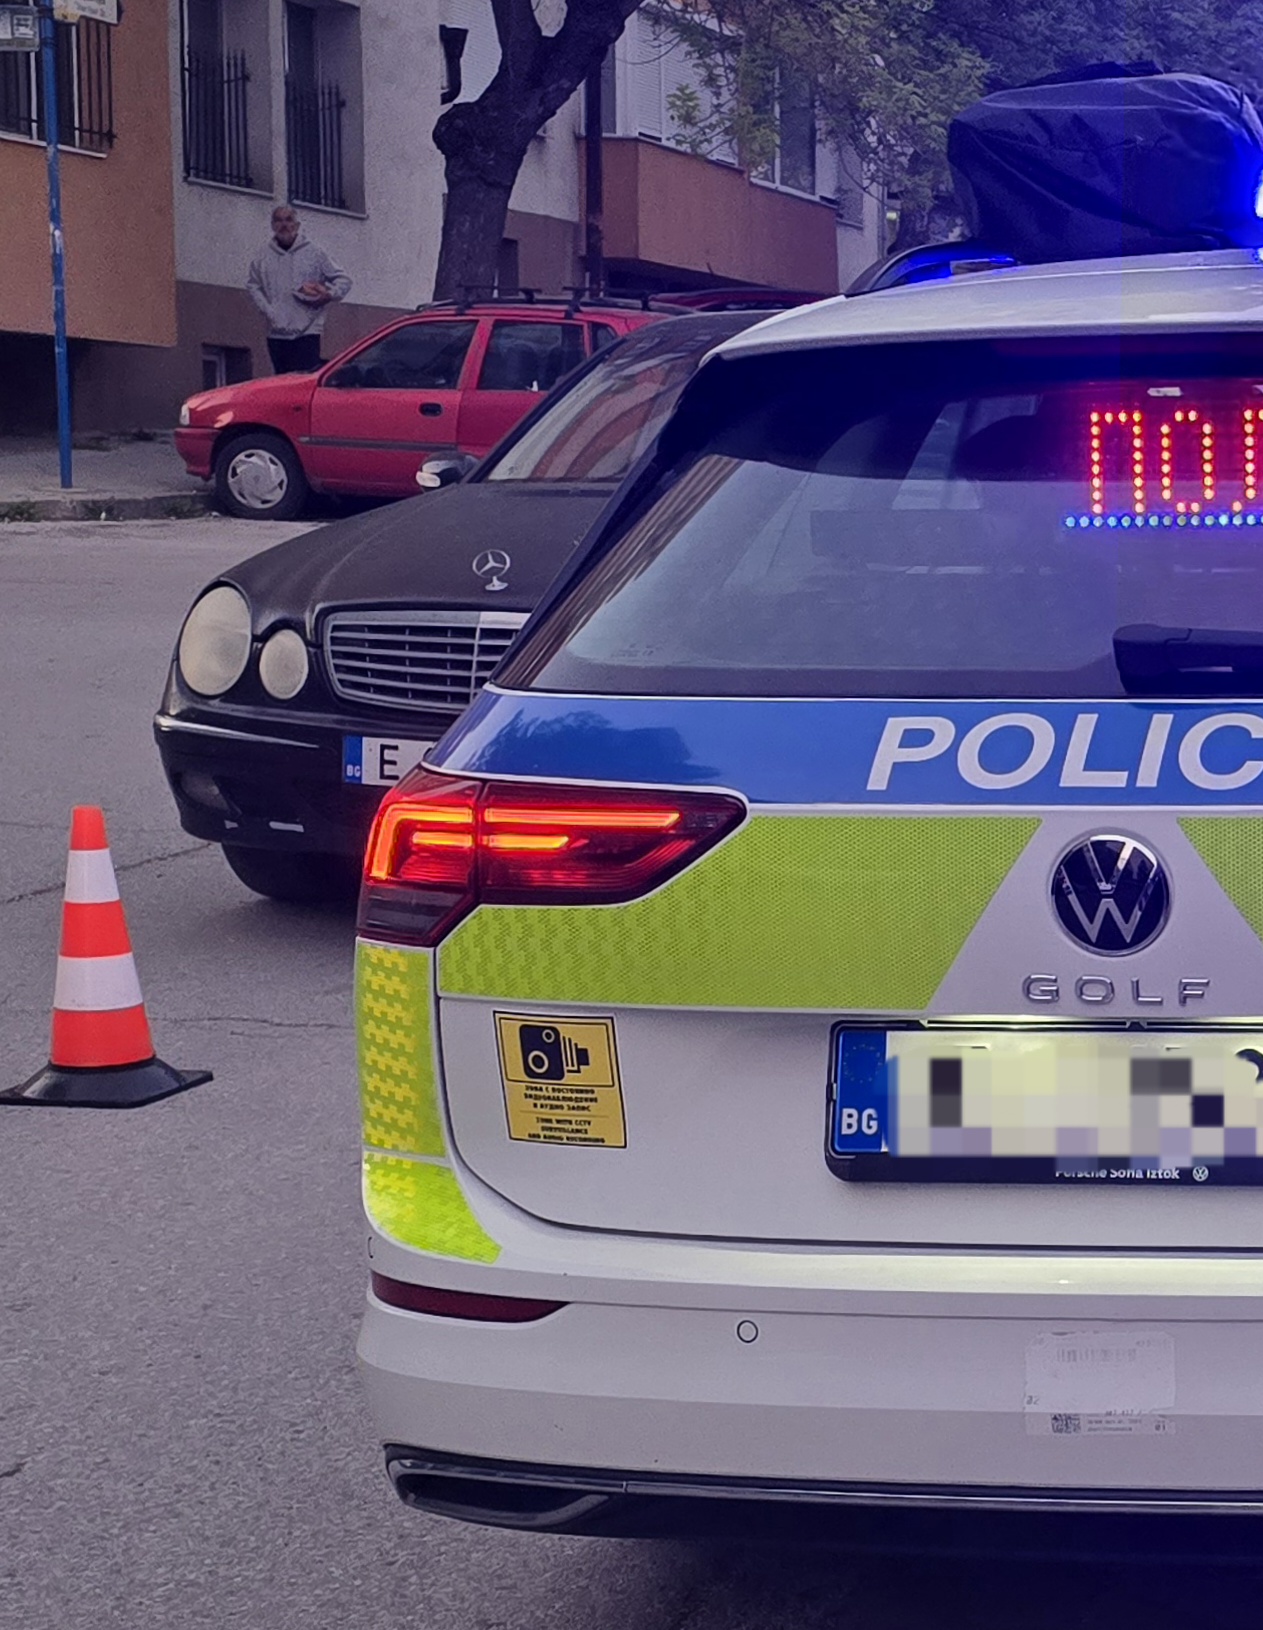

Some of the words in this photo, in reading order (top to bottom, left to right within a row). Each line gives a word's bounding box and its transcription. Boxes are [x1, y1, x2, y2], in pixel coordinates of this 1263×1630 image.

[346, 764, 361, 778] BG
[1022, 973, 1211, 1006] GOLF
[841, 1108, 878, 1135] BG
